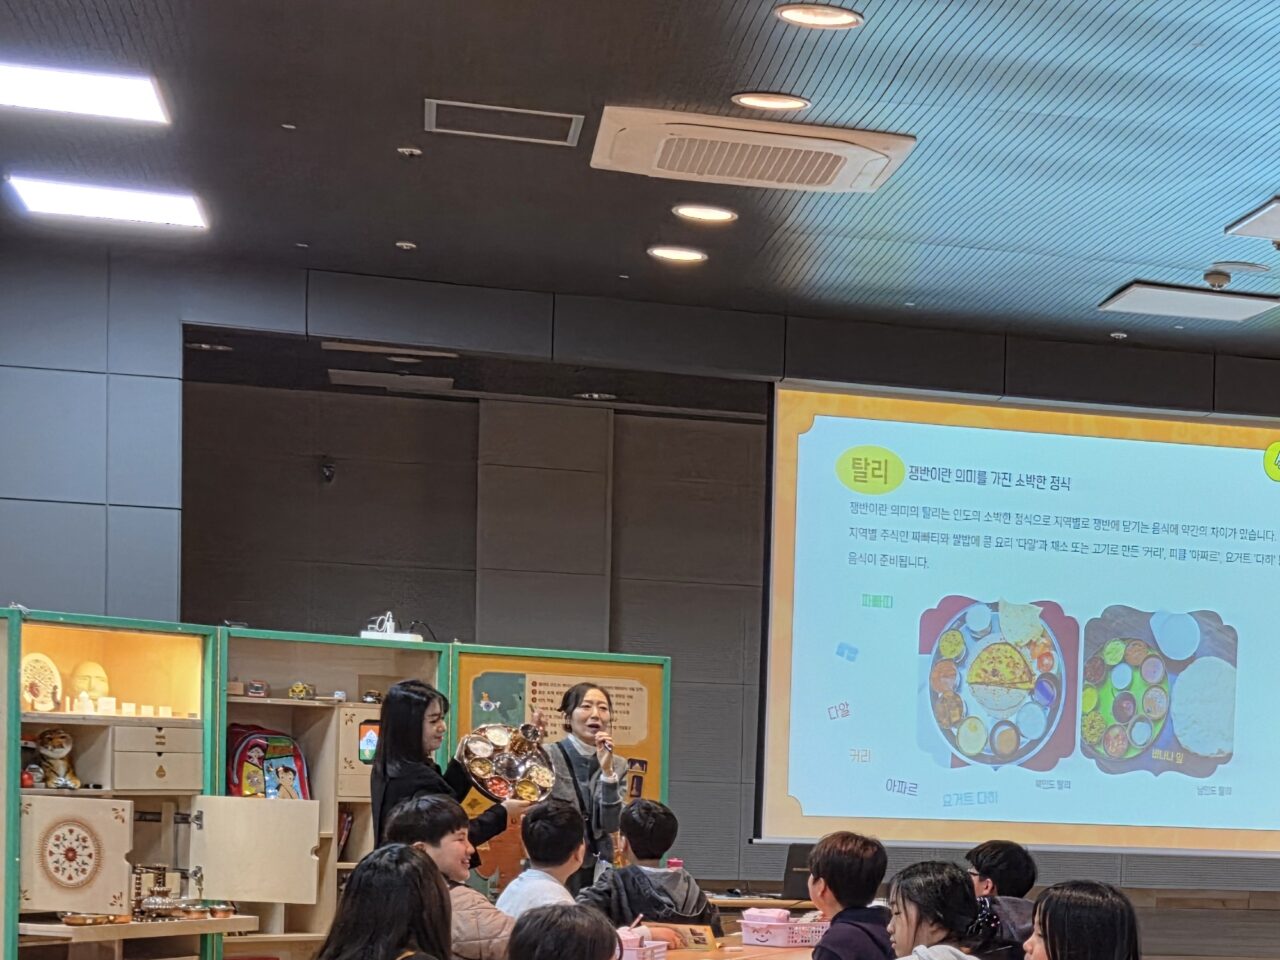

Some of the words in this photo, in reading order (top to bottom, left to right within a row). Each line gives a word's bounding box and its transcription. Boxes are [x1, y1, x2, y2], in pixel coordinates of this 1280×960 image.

[852, 457, 888, 485] 탈리
[908, 465, 951, 483] 쟁반이란
[955, 468, 988, 486] 의미를
[991, 471, 1012, 488] 가진
[1015, 473, 1047, 490] 소박한
[1050, 475, 1071, 492] 정식
[890, 504, 919, 518] 의미의
[953, 509, 981, 522] 인도의
[984, 512, 1011, 525] 소박한
[1015, 513, 1051, 526] 정식으로
[1054, 516, 1090, 530] 지역별로
[1122, 520, 1150, 534] 담기는
[1152, 522, 1179, 535] 음식에
[1181, 524, 1208, 537] 약간의
[1211, 526, 1237, 539] 차이가
[848, 552, 877, 565] 음식이
[849, 527, 877, 541] 지역별
[995, 537, 1013, 549] 요리
[1051, 540, 1068, 552] 채소
[1071, 542, 1089, 554] 또는
[1092, 543, 1119, 556] 고기로
[1122, 545, 1140, 558] 만든
[1225, 552, 1253, 564] 요거트
